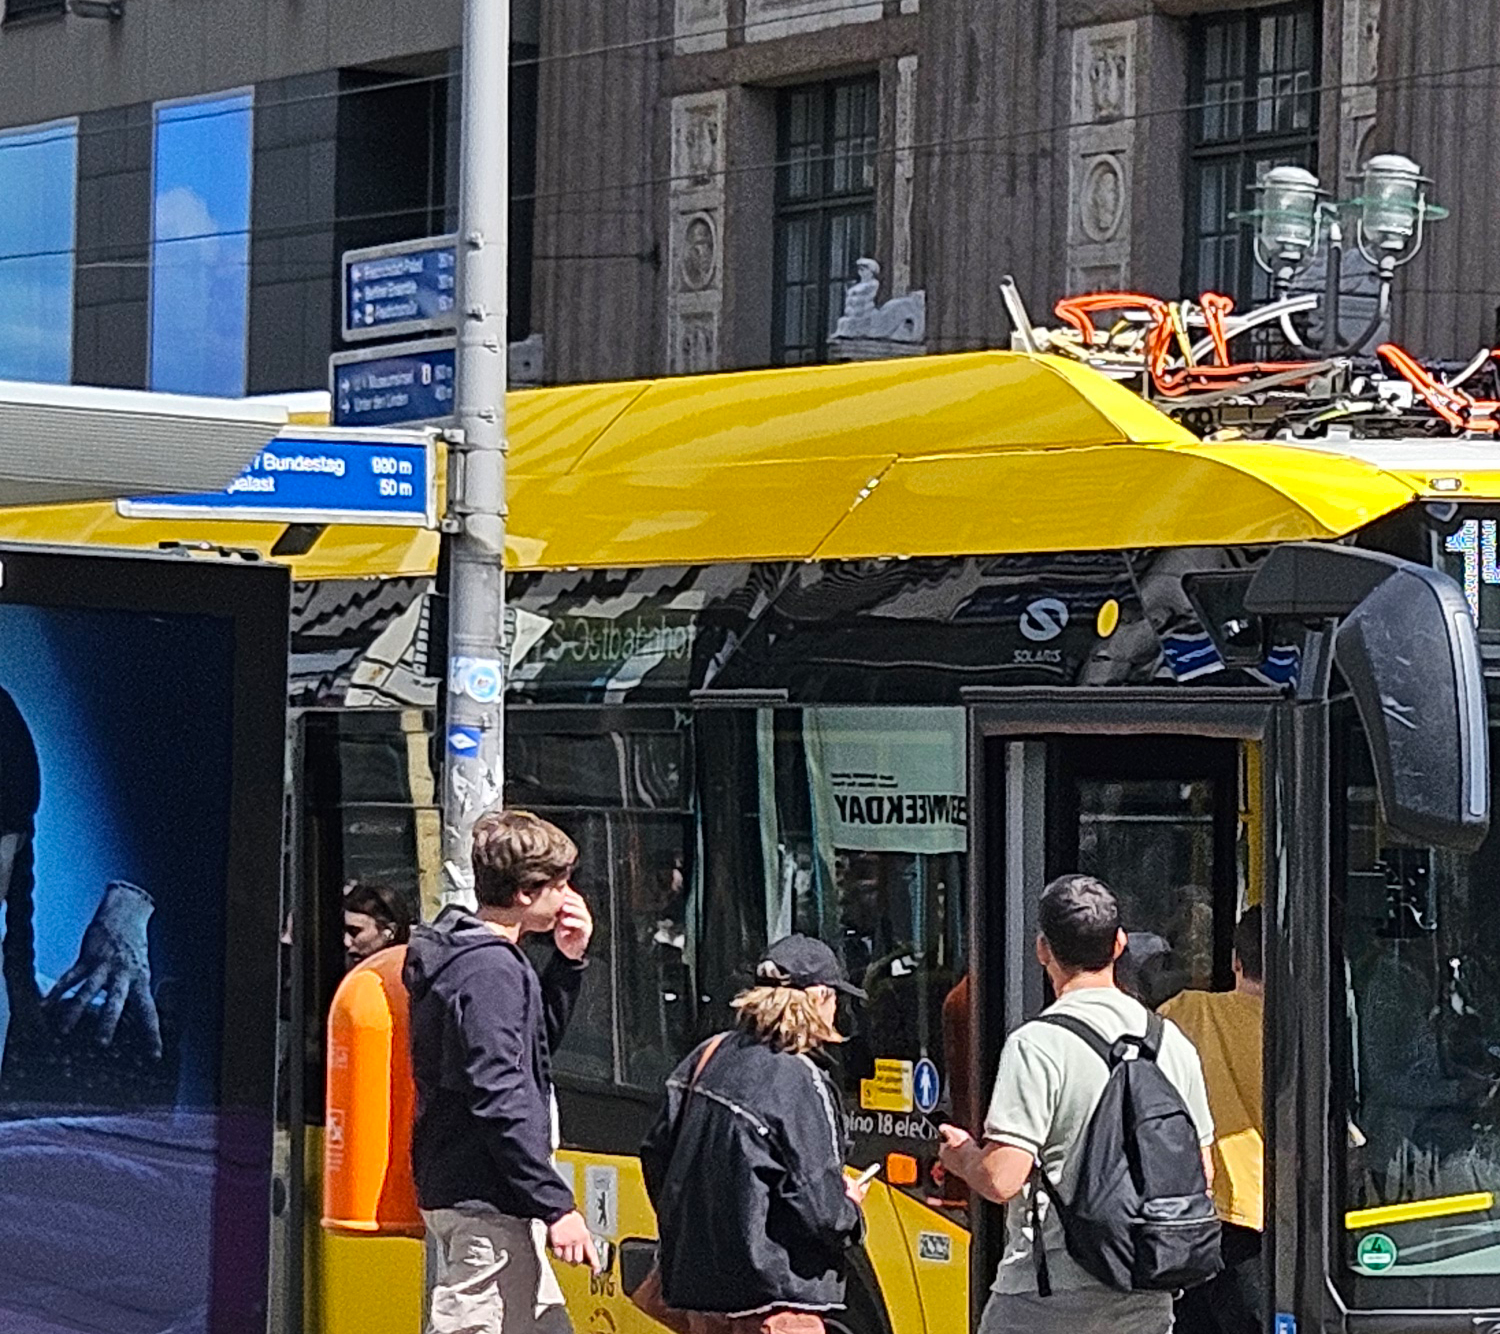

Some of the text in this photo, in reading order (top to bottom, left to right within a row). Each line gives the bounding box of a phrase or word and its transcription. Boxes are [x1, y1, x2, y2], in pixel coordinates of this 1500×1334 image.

[263, 452, 346, 476] Bundestag
[399, 460, 412, 475] m
[380, 478, 397, 496] 50
[399, 481, 412, 496] m
[571, 614, 697, 661] Ostbahnhof
[1013, 649, 1062, 663] SOLARIS
[878, 1112, 893, 1135] 18
